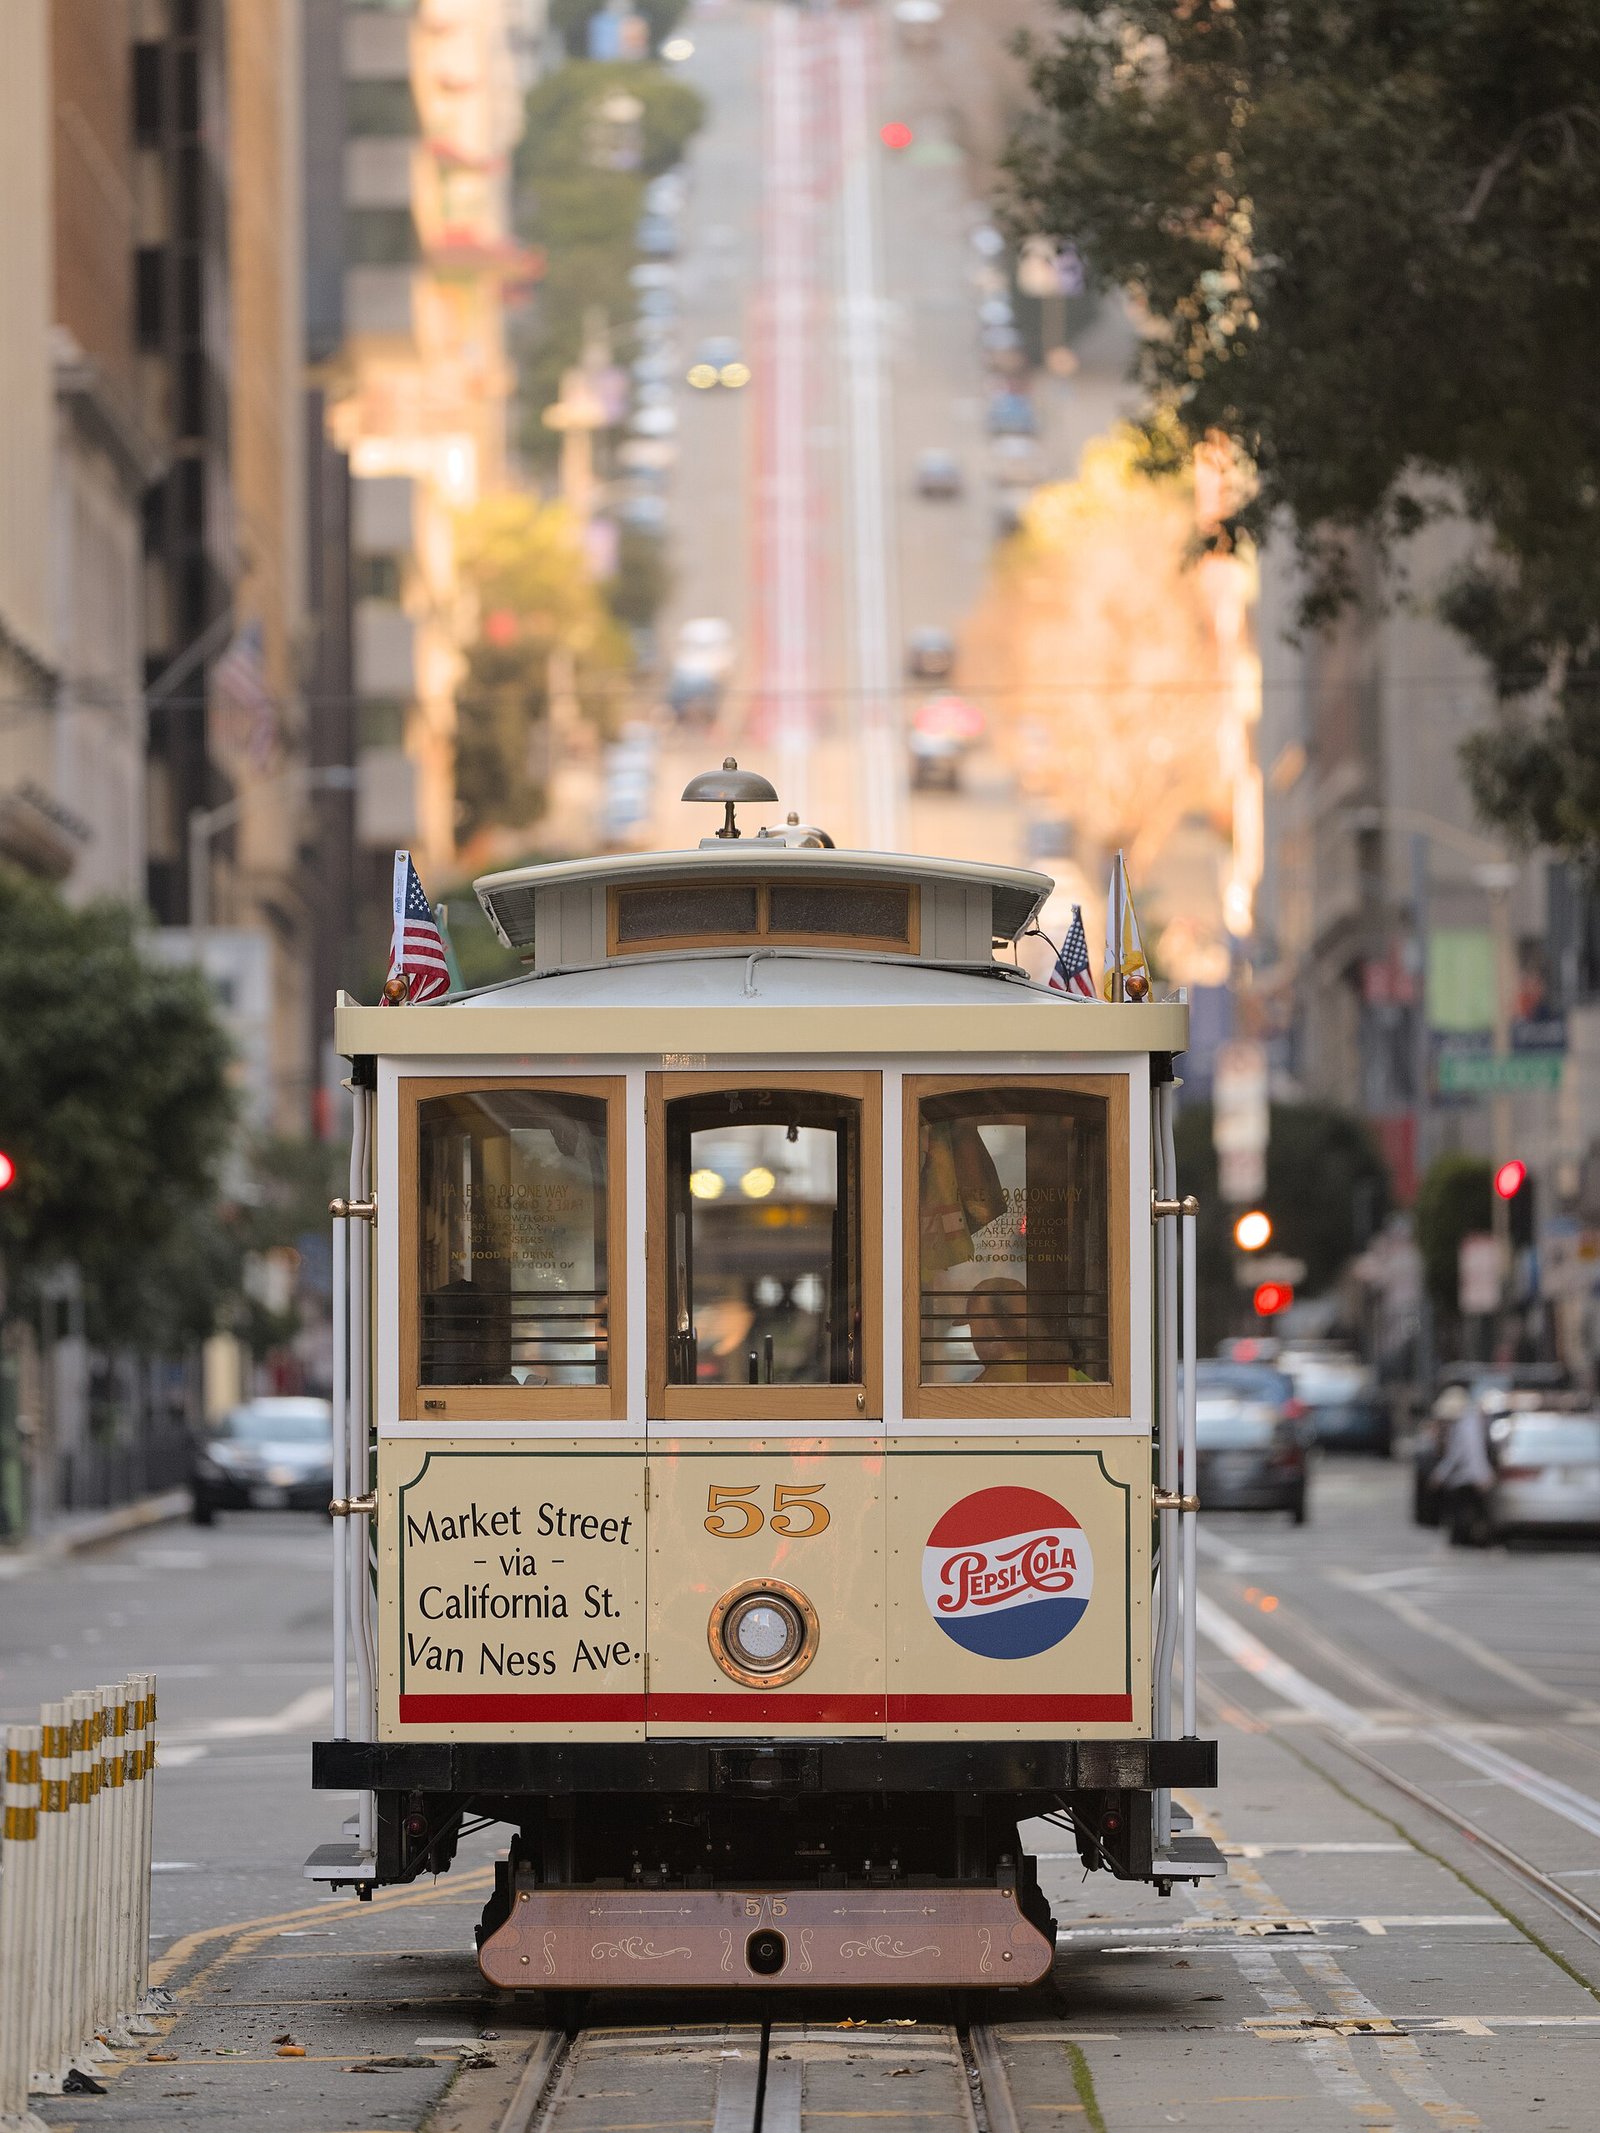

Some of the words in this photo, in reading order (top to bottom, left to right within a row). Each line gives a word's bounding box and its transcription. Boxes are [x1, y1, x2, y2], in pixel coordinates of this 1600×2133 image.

[442, 1184, 482, 1198] AES
[544, 1184, 569, 1198] WAY
[1030, 1188, 1056, 1202] ONE
[984, 1227, 1014, 1235] AREA
[981, 1239, 996, 1248] NO
[451, 1251, 467, 1260] NO
[471, 1251, 501, 1260] FOOD
[522, 1250, 555, 1260] DRINK
[967, 1253, 983, 1263] NO
[987, 1253, 1016, 1263] FOOD
[1037, 1253, 1072, 1262] DRINK
[703, 1483, 831, 1540] 55
[408, 1503, 522, 1548] Market
[537, 1502, 633, 1545] Street
[498, 1546, 538, 1576] via
[419, 1583, 569, 1620] California
[584, 1584, 621, 1619] St.
[407, 1632, 464, 1673] Van
[479, 1642, 556, 1677] Ness
[572, 1639, 641, 1673] Ave.
